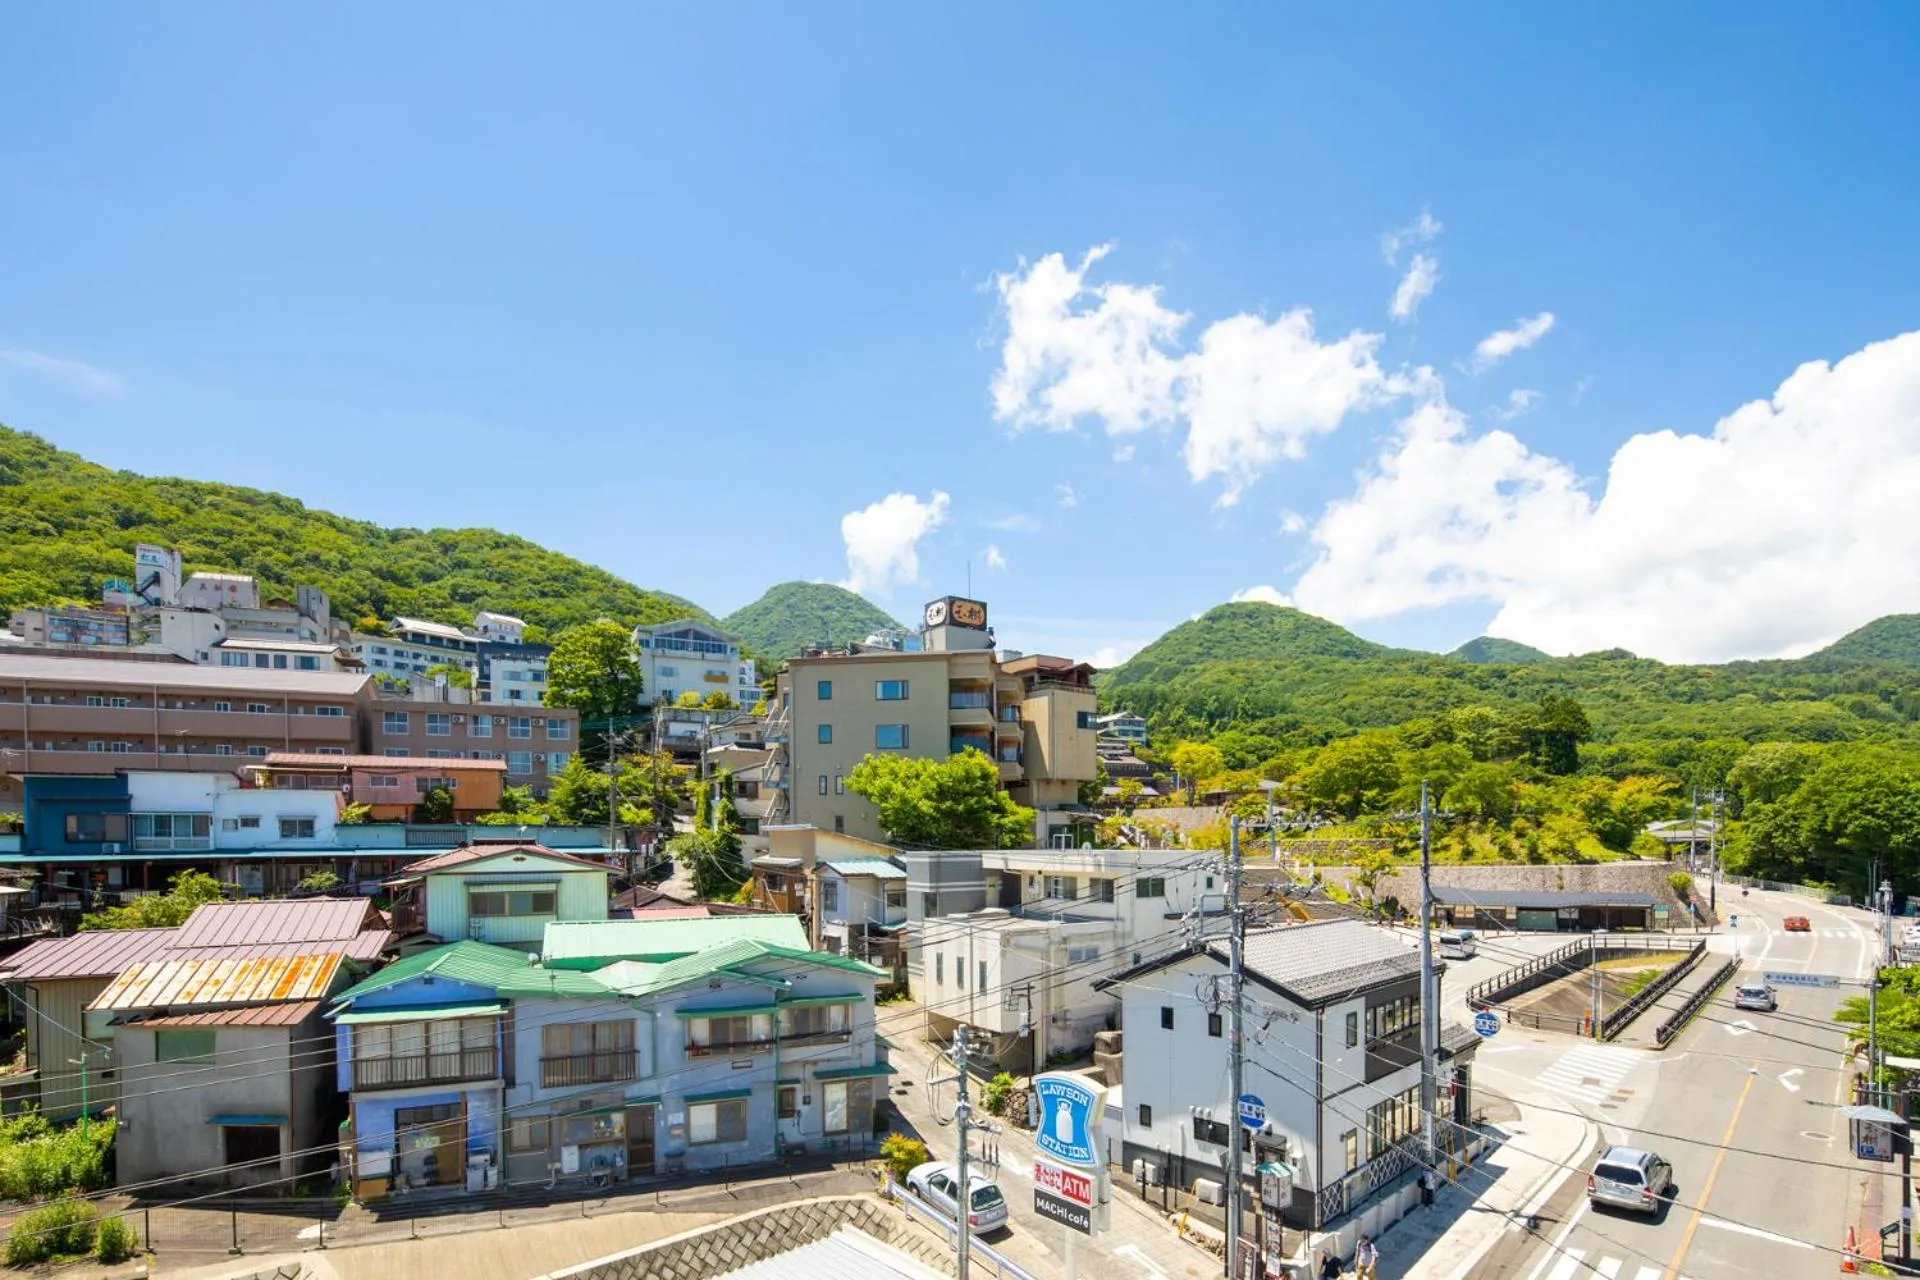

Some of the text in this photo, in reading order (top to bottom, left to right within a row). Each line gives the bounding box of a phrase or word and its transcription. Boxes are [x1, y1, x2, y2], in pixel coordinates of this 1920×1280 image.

[1041, 1083, 1089, 1107] LAWSON
[1041, 1134, 1089, 1158] STATION
[1063, 1175, 1090, 1201] ATM
[1036, 1197, 1068, 1219] MACHI
